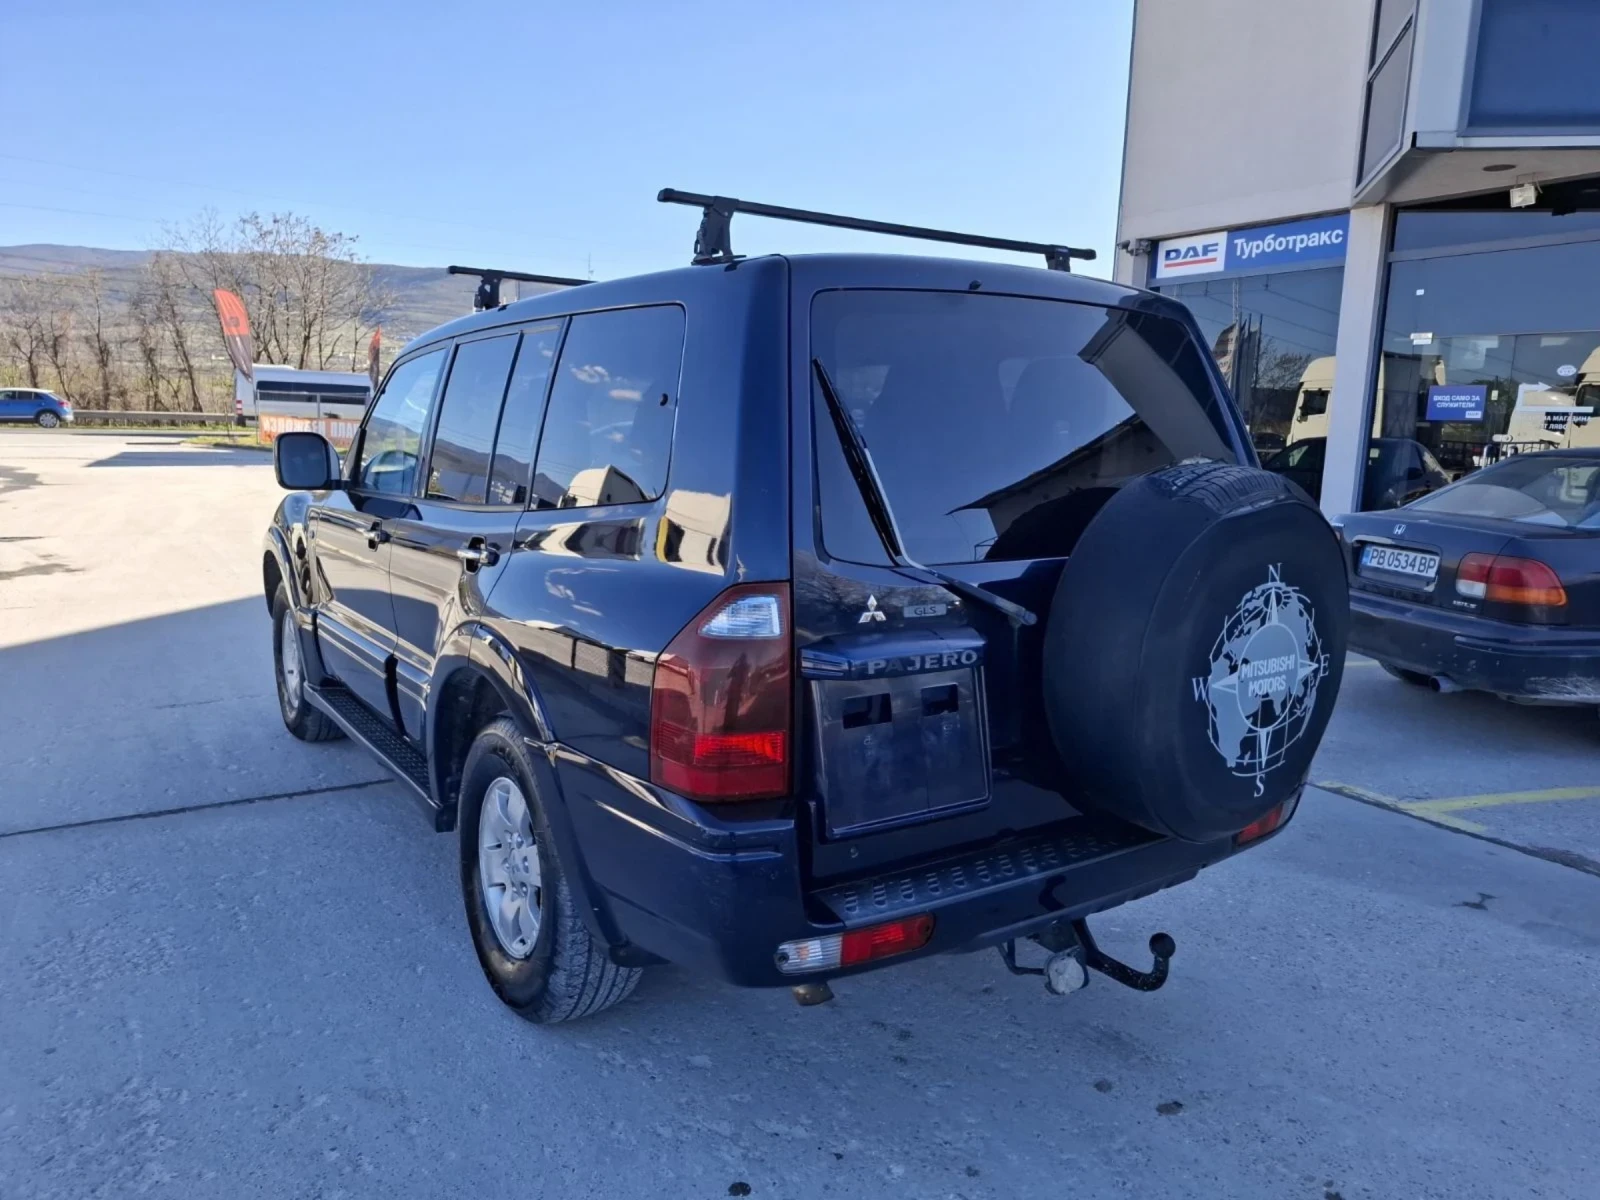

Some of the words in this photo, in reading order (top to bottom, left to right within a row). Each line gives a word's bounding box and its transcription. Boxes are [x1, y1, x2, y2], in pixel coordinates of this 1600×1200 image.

[1164, 242, 1219, 262] DAF
[1233, 229, 1344, 259] Турботракс
[1268, 562, 1282, 585] N
[1370, 548, 1387, 569] PB
[1387, 551, 1416, 571] 0534
[1417, 557, 1437, 575] BP
[914, 606, 937, 616] GLS
[867, 649, 978, 675] PAJERO
[1241, 654, 1296, 680] MITSUBISHI
[1319, 653, 1330, 678] E
[1192, 677, 1210, 702] W
[1248, 674, 1287, 697] MOTORS
[1254, 773, 1265, 798] S
